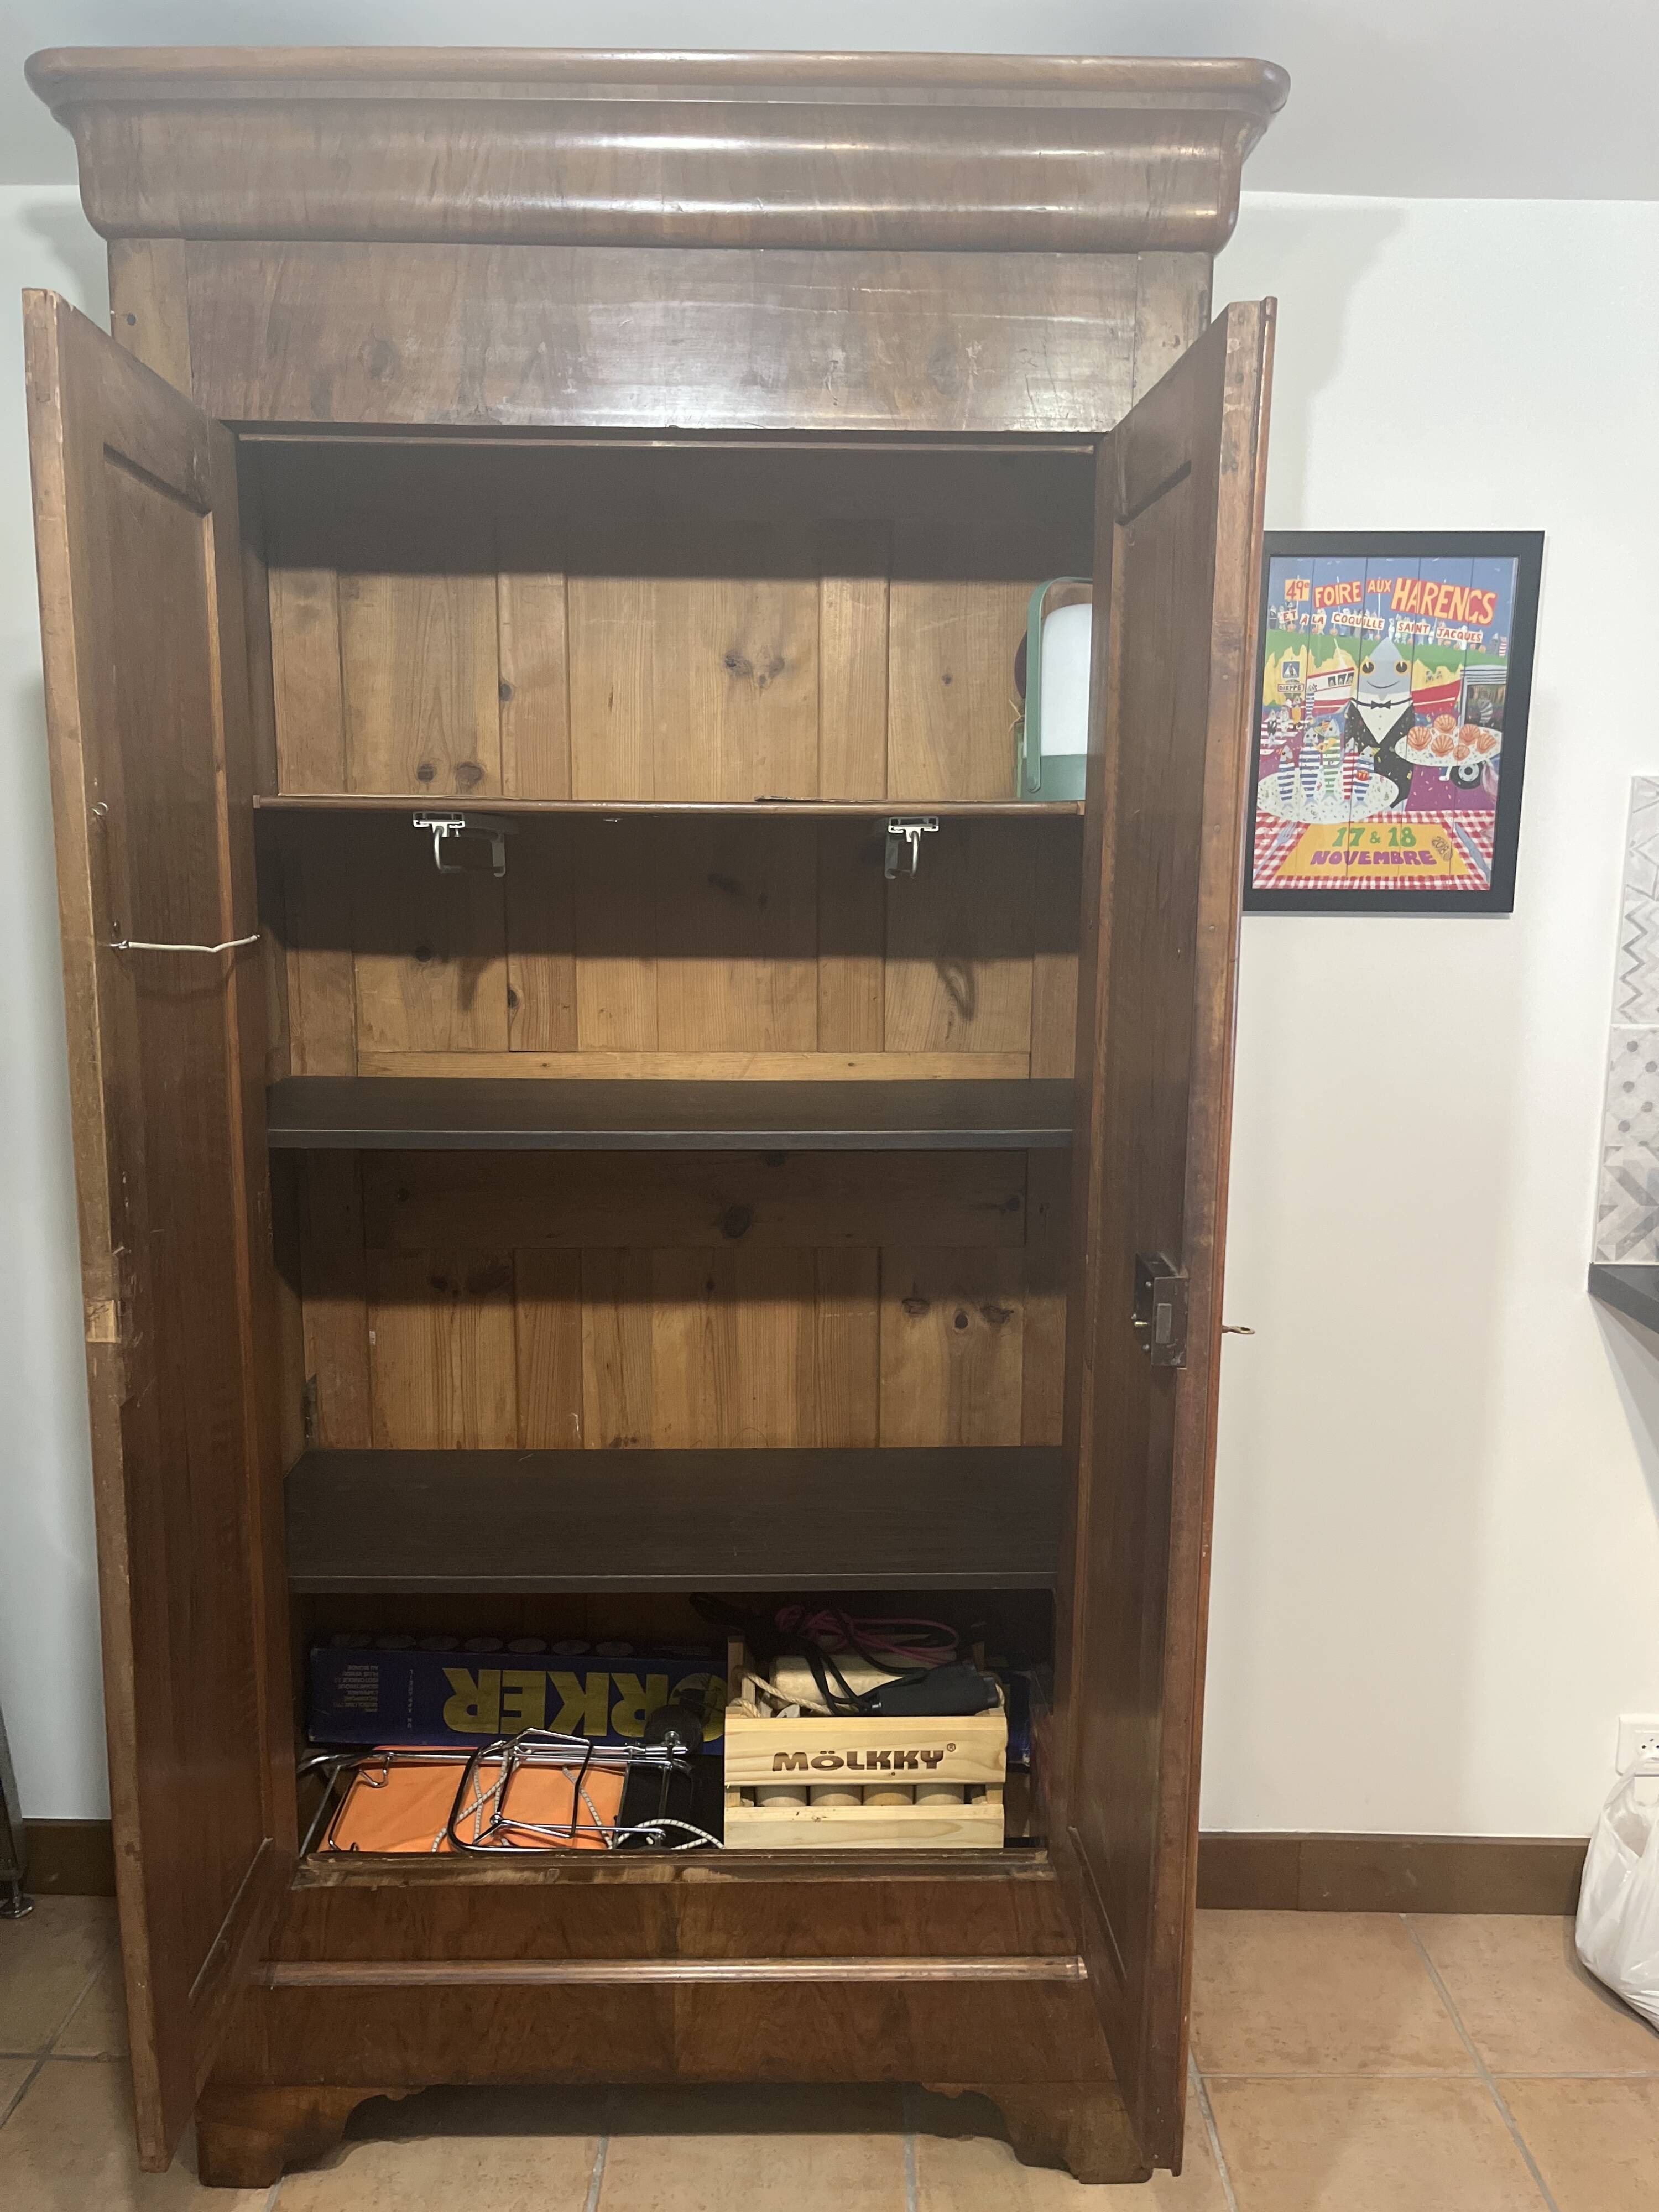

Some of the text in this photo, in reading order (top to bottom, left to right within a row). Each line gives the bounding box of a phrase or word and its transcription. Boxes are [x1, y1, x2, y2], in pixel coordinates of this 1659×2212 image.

[1315, 581, 1361, 607] FOIRE
[1367, 580, 1391, 593] AUX
[1283, 611, 1297, 622] ET
[1311, 615, 1324, 624] LA
[1333, 613, 1384, 629] COQUILLE
[1398, 623, 1430, 634] SAINT
[1437, 629, 1483, 643] JACQUES
[1332, 827, 1416, 847] 17 & 18
[1310, 850, 1437, 865] NOVEMBRE
[444, 1667, 727, 1741] ORKER
